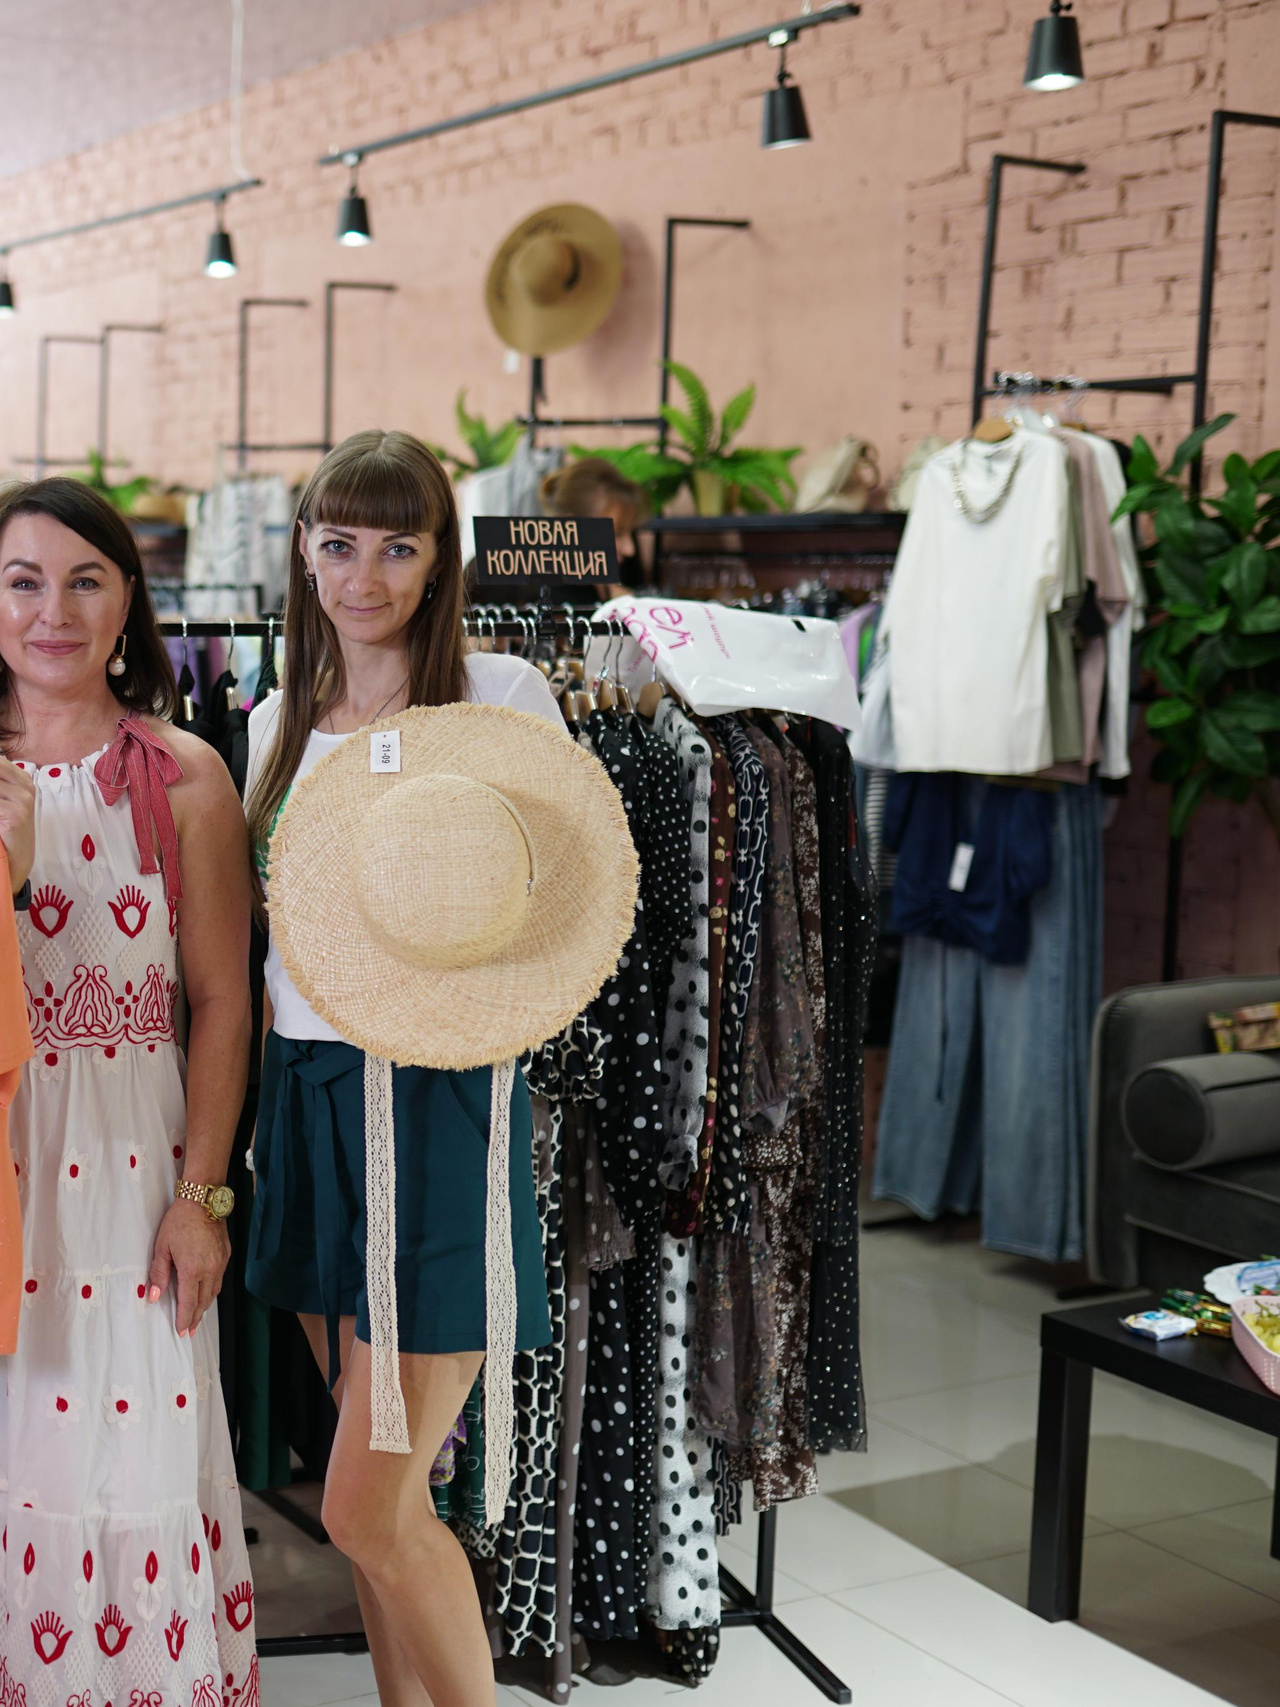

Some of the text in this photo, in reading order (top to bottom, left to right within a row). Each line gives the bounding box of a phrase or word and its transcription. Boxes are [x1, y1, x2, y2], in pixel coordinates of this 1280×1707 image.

[509, 520, 579, 546] НОВАЯ
[486, 549, 608, 580] КОЛЛЕКЦИЯ
[381, 744, 391, 764] 21-09
